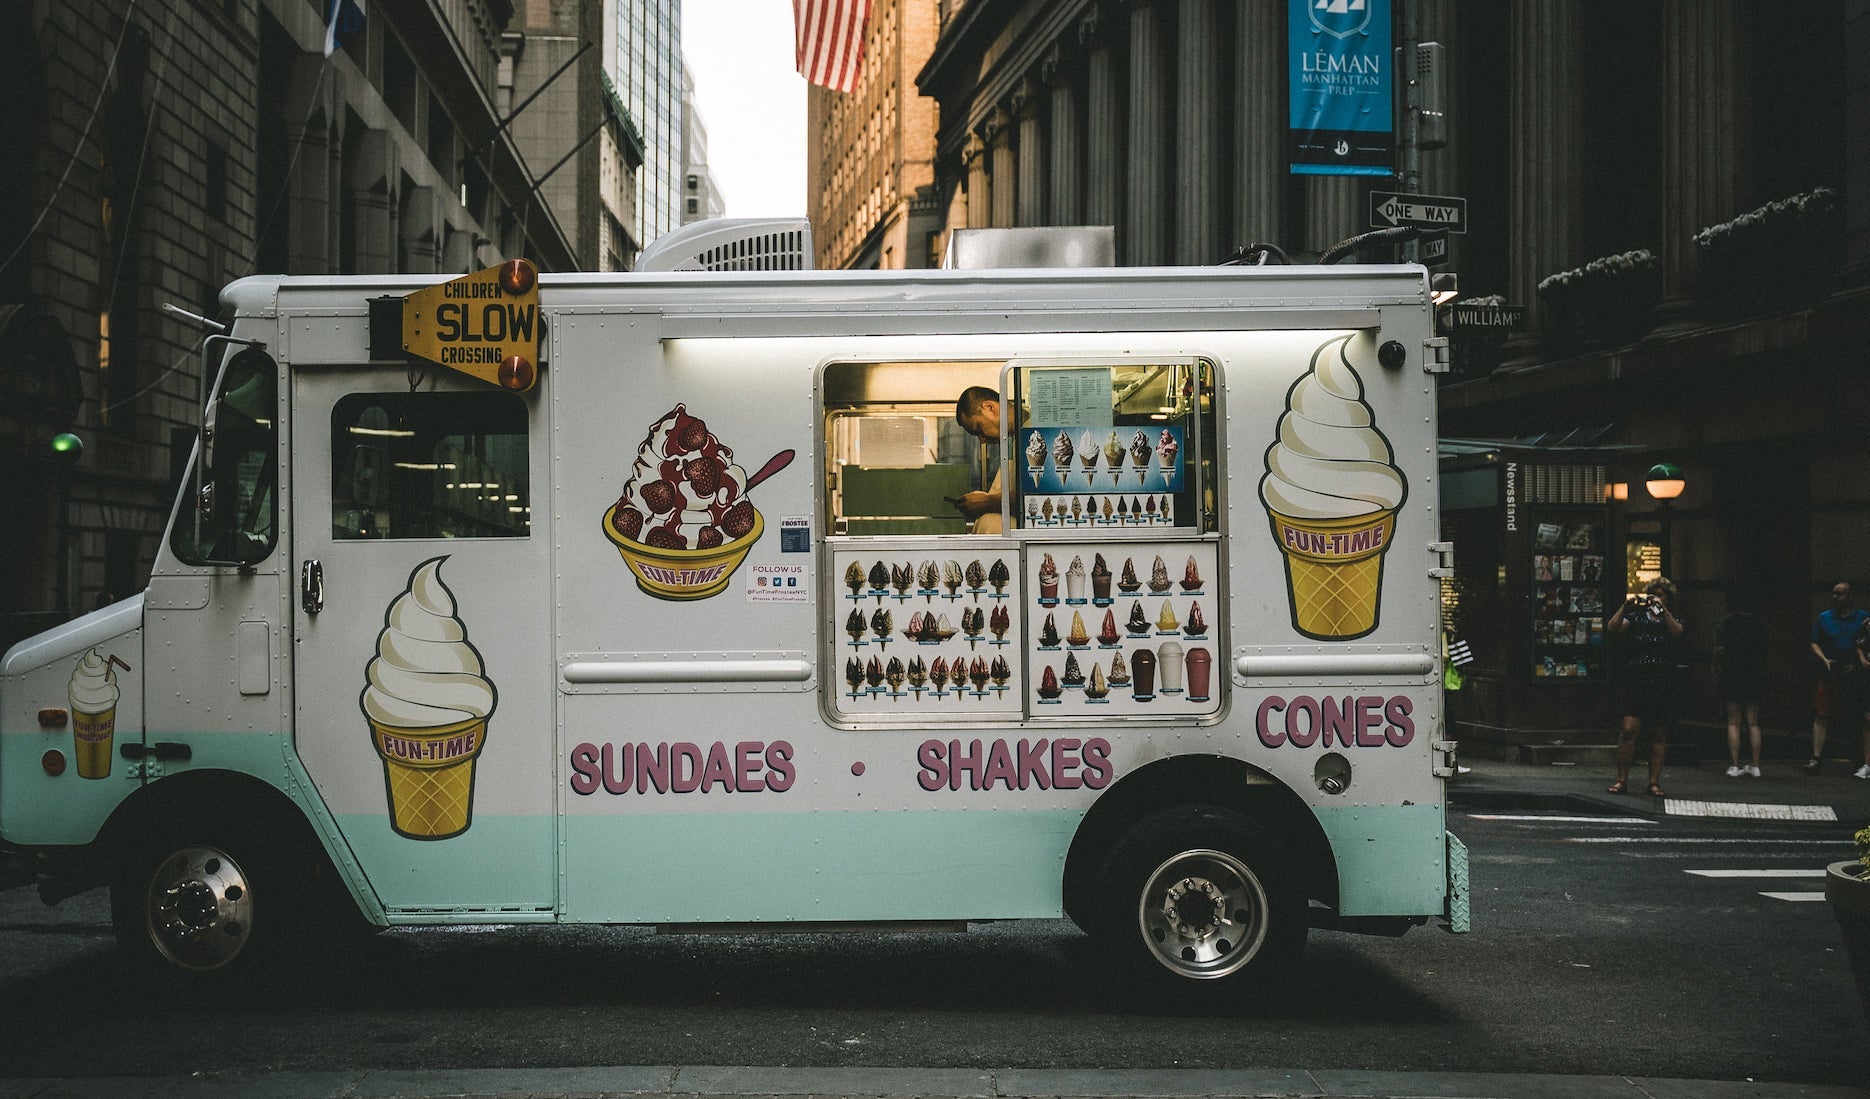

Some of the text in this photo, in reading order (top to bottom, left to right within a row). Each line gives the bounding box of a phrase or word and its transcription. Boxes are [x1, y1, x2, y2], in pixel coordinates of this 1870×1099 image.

[1302, 74, 1379, 85] MANHATTAN
[1328, 86, 1355, 96] PREP
[1386, 203, 1453, 222] ONE WAY
[444, 282, 502, 299] CHILDREN
[436, 303, 535, 343] SLOW
[1458, 310, 1513, 326] WILLIAM
[441, 347, 503, 364] CROSSING
[1506, 462, 1517, 531] Newsstand
[1282, 524, 1385, 556] FUN-TIME
[635, 560, 730, 587] FUN-TIME
[753, 565, 789, 573] FOLLOW
[1255, 695, 1415, 748] CONES
[382, 731, 477, 761] FUN-TIME
[570, 737, 1114, 795] SUNDAES SHAKES
